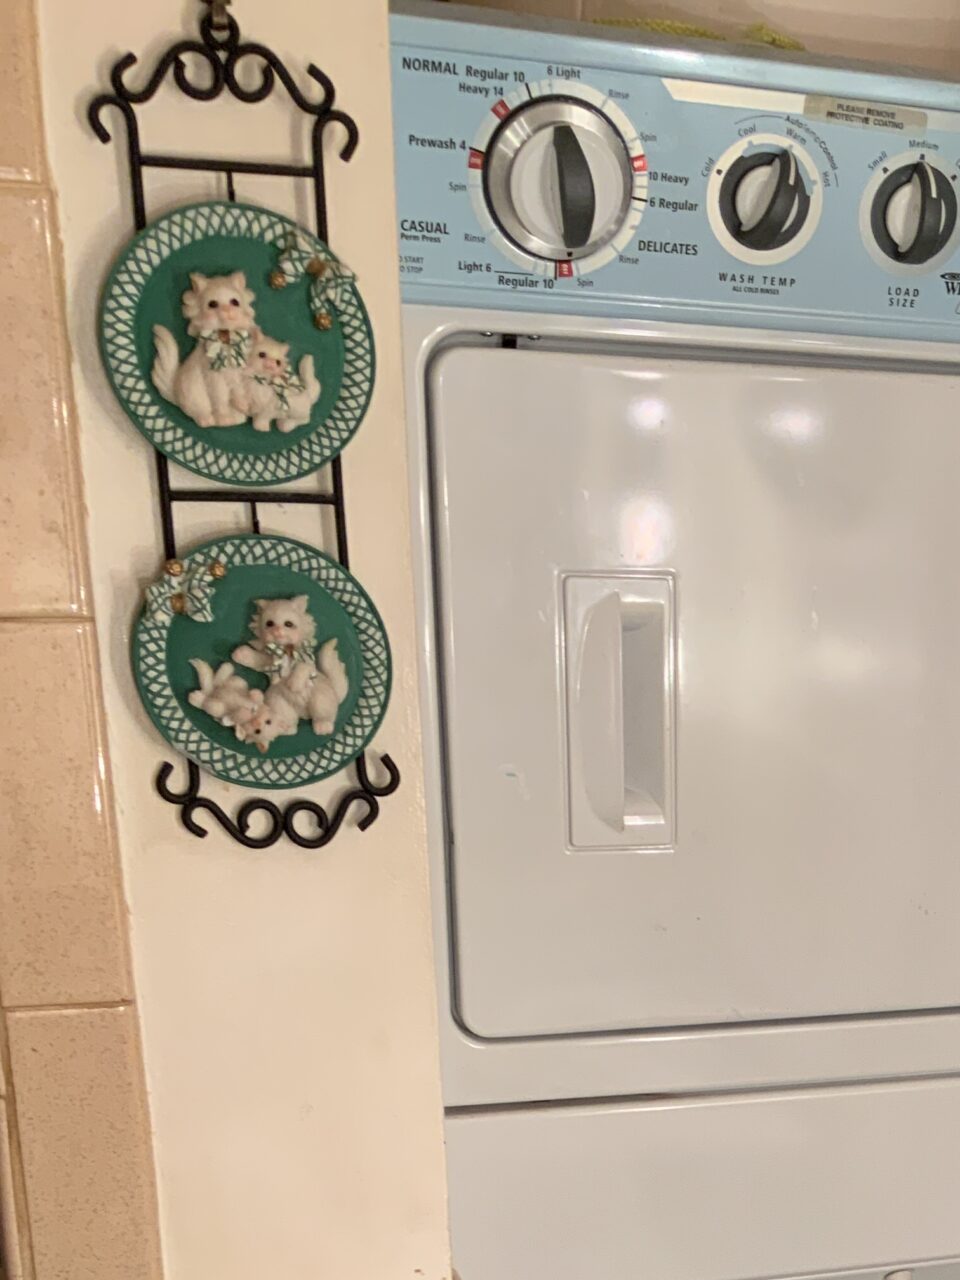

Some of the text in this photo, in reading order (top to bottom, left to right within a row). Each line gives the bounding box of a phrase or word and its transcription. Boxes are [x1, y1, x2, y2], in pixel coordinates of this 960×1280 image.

[402, 57, 459, 75] NORMAL
[547, 65, 581, 80] 6 Light
[466, 65, 525, 82] Regular 10
[459, 82, 505, 98] Heavy 14
[640, 132, 657, 142] Spin
[738, 123, 756, 137] Cool
[408, 134, 466, 150] Prewash 4
[908, 139, 939, 151] Medium
[701, 157, 714, 178] Cold
[867, 150, 888, 171] Small
[649, 172, 689, 186] 10 Heavy
[449, 181, 467, 192] Spin
[650, 197, 699, 212] 6 Regular
[400, 219, 450, 235] CASUAL
[464, 233, 486, 243] Rinse
[638, 240, 699, 256] DELICATES
[458, 261, 492, 273] Light 6
[619, 255, 640, 265] Rinse
[498, 275, 554, 289] Regular 10
[577, 278, 594, 288] Spin
[719, 272, 796, 288] WASH TEMP
[888, 286, 920, 298] LOAD
[888, 297, 916, 308] SIZE
